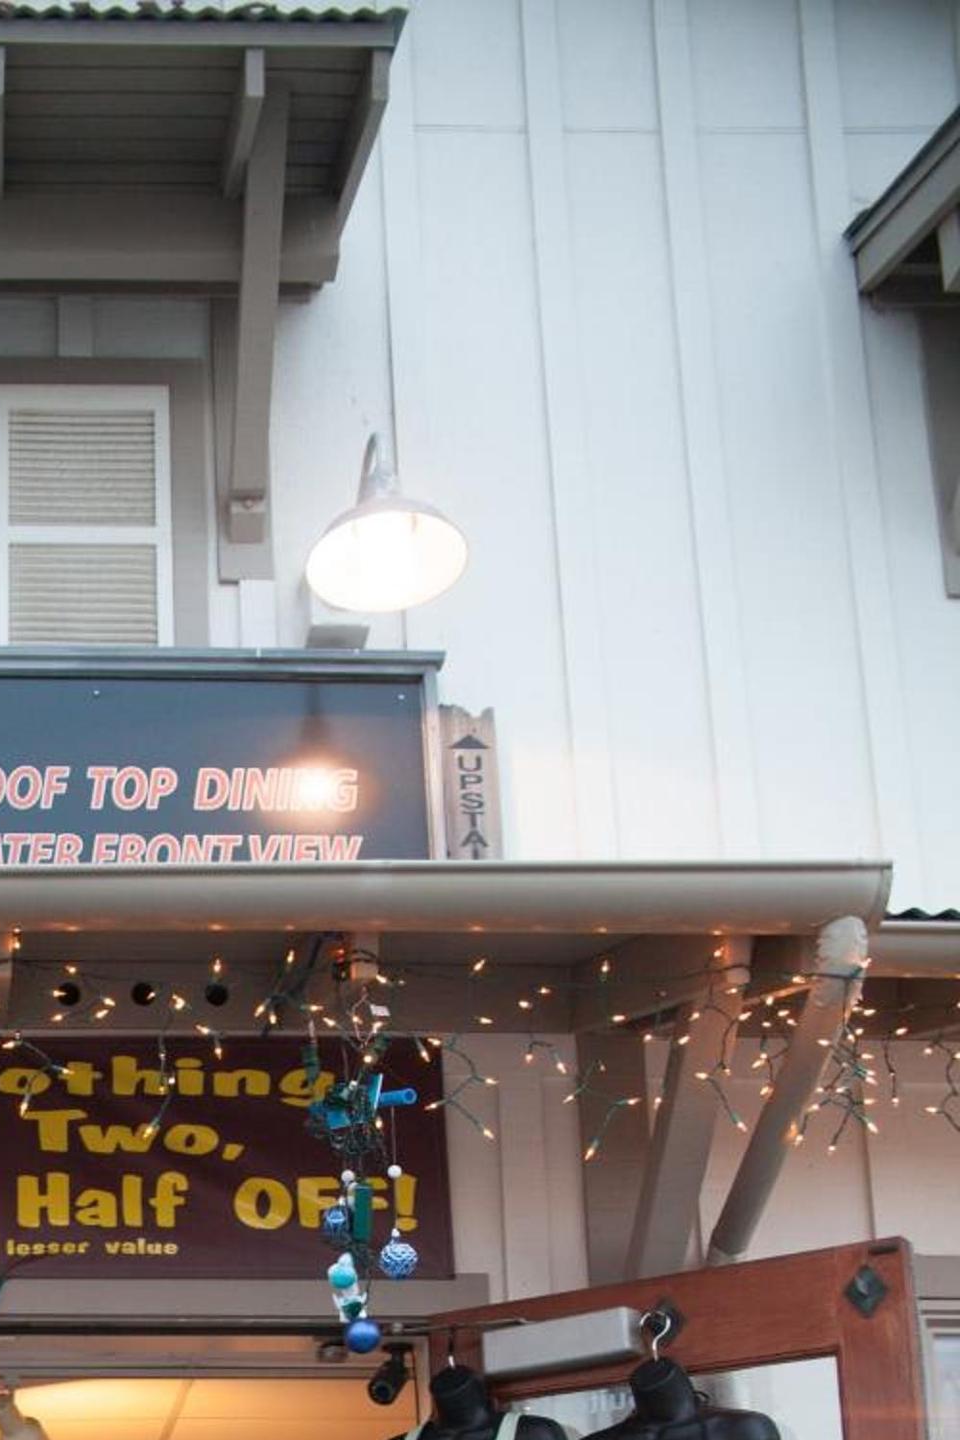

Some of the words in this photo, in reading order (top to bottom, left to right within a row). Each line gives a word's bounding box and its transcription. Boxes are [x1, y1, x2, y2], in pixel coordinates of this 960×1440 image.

[86, 765, 178, 811] TOP
[456, 754, 490, 861] UPSTAI
[91, 833, 243, 863] FRONT
[248, 834, 365, 862] VIEW
[23, 1108, 245, 1161] Two,
[15, 1170, 190, 1229] Half
[6, 1238, 91, 1257] lesser
[105, 1238, 180, 1256] value
